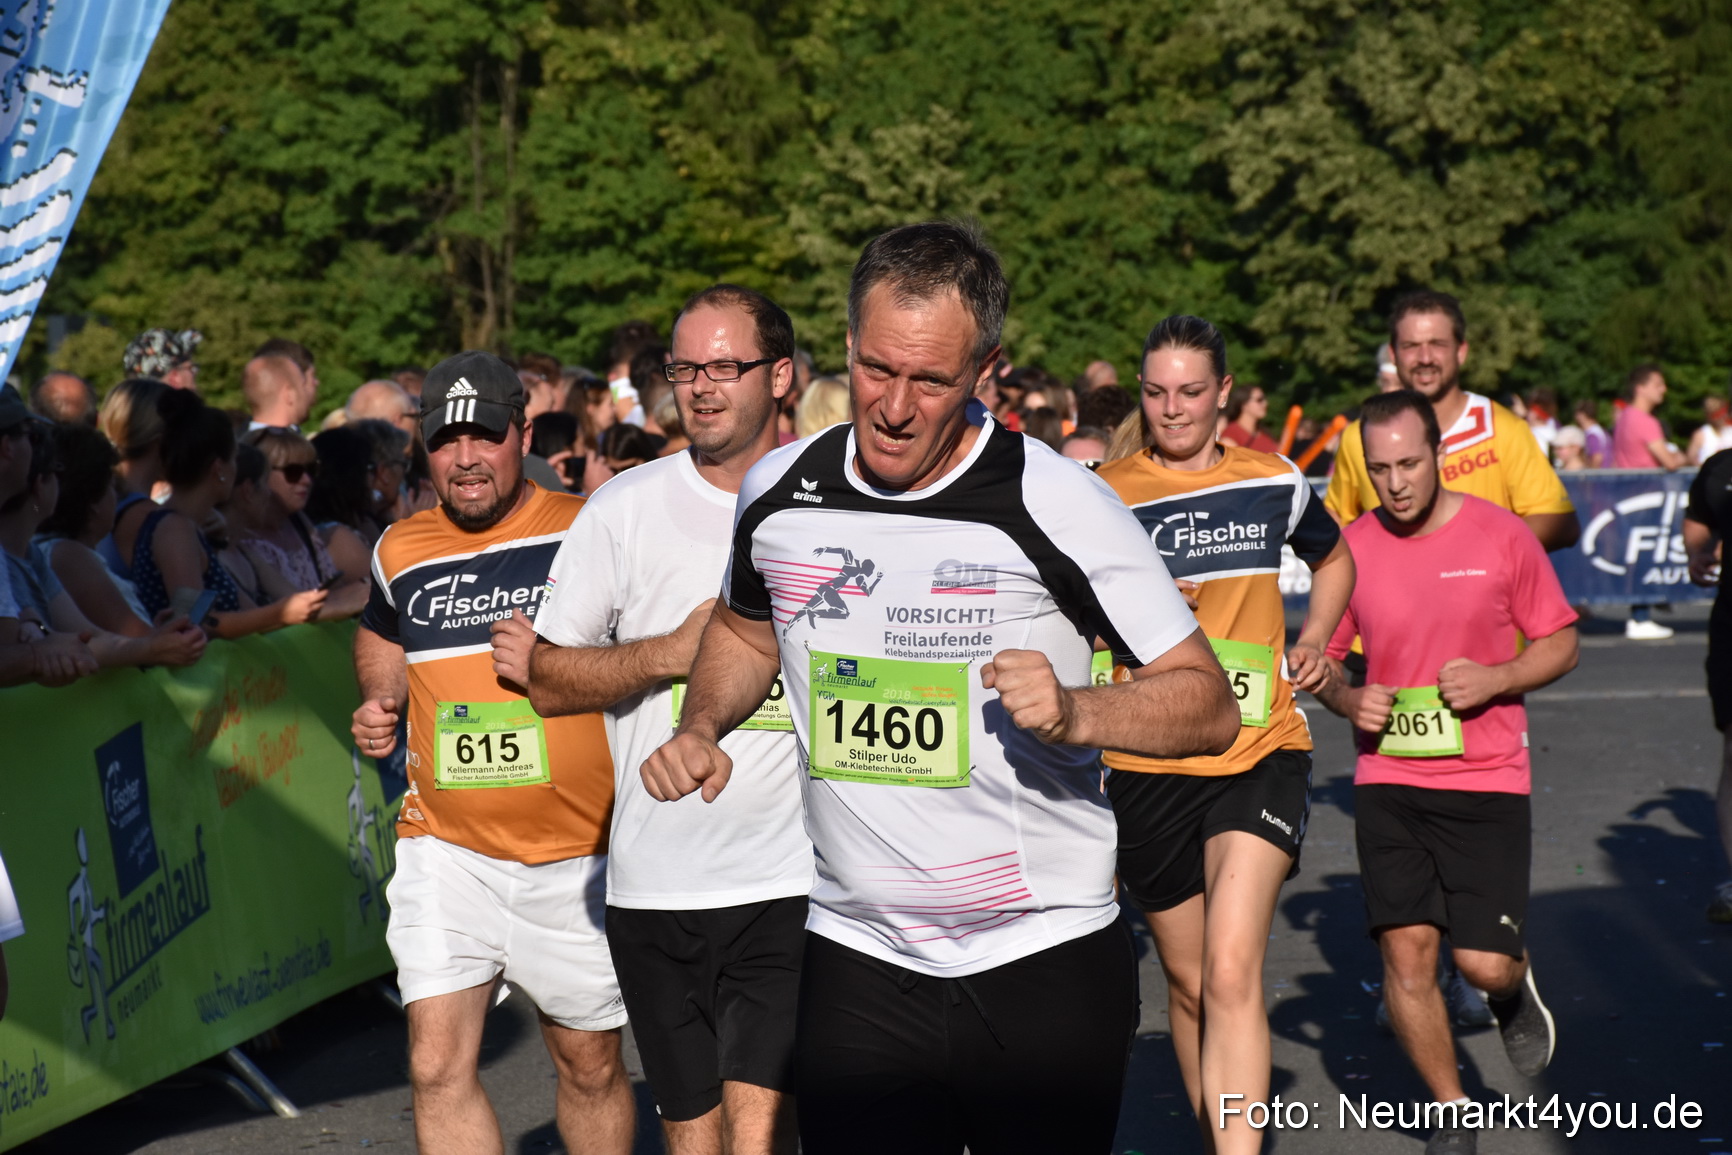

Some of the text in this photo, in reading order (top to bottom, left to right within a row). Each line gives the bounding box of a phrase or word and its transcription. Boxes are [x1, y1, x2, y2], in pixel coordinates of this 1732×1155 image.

[446, 389, 478, 399] adidas
[1442, 448, 1499, 482] BÖGL
[793, 491, 823, 504] erima
[1174, 521, 1267, 549] Fischer
[1625, 526, 1688, 564] Fis
[1186, 541, 1266, 558] AUTOMOBILE
[934, 559, 998, 583] OM
[429, 585, 547, 618] Fischer
[441, 605, 536, 630] AUTOMOBLE
[886, 606, 995, 624] VORSICHT!
[884, 631, 993, 647] Freilaufende
[884, 647, 992, 660] Klebebandspezialisten
[827, 672, 877, 688] firmenlauf
[1226, 671, 1249, 700] 5
[883, 688, 911, 700] 2018
[827, 700, 944, 751] 1460
[1385, 711, 1444, 736] 2061
[456, 733, 520, 764] 615
[849, 748, 917, 765] Stilper Udo
[447, 762, 534, 774] Kellermann Andreas
[475, 773, 508, 781] Automobile
[510, 771, 529, 779] GmbH
[834, 760, 932, 775] OM-Klebetechnik GmbH
[112, 778, 140, 816] Fischer
[1261, 809, 1293, 836] hummel
[105, 824, 210, 988] firmenlauf
[117, 964, 163, 1022] neumarkt
